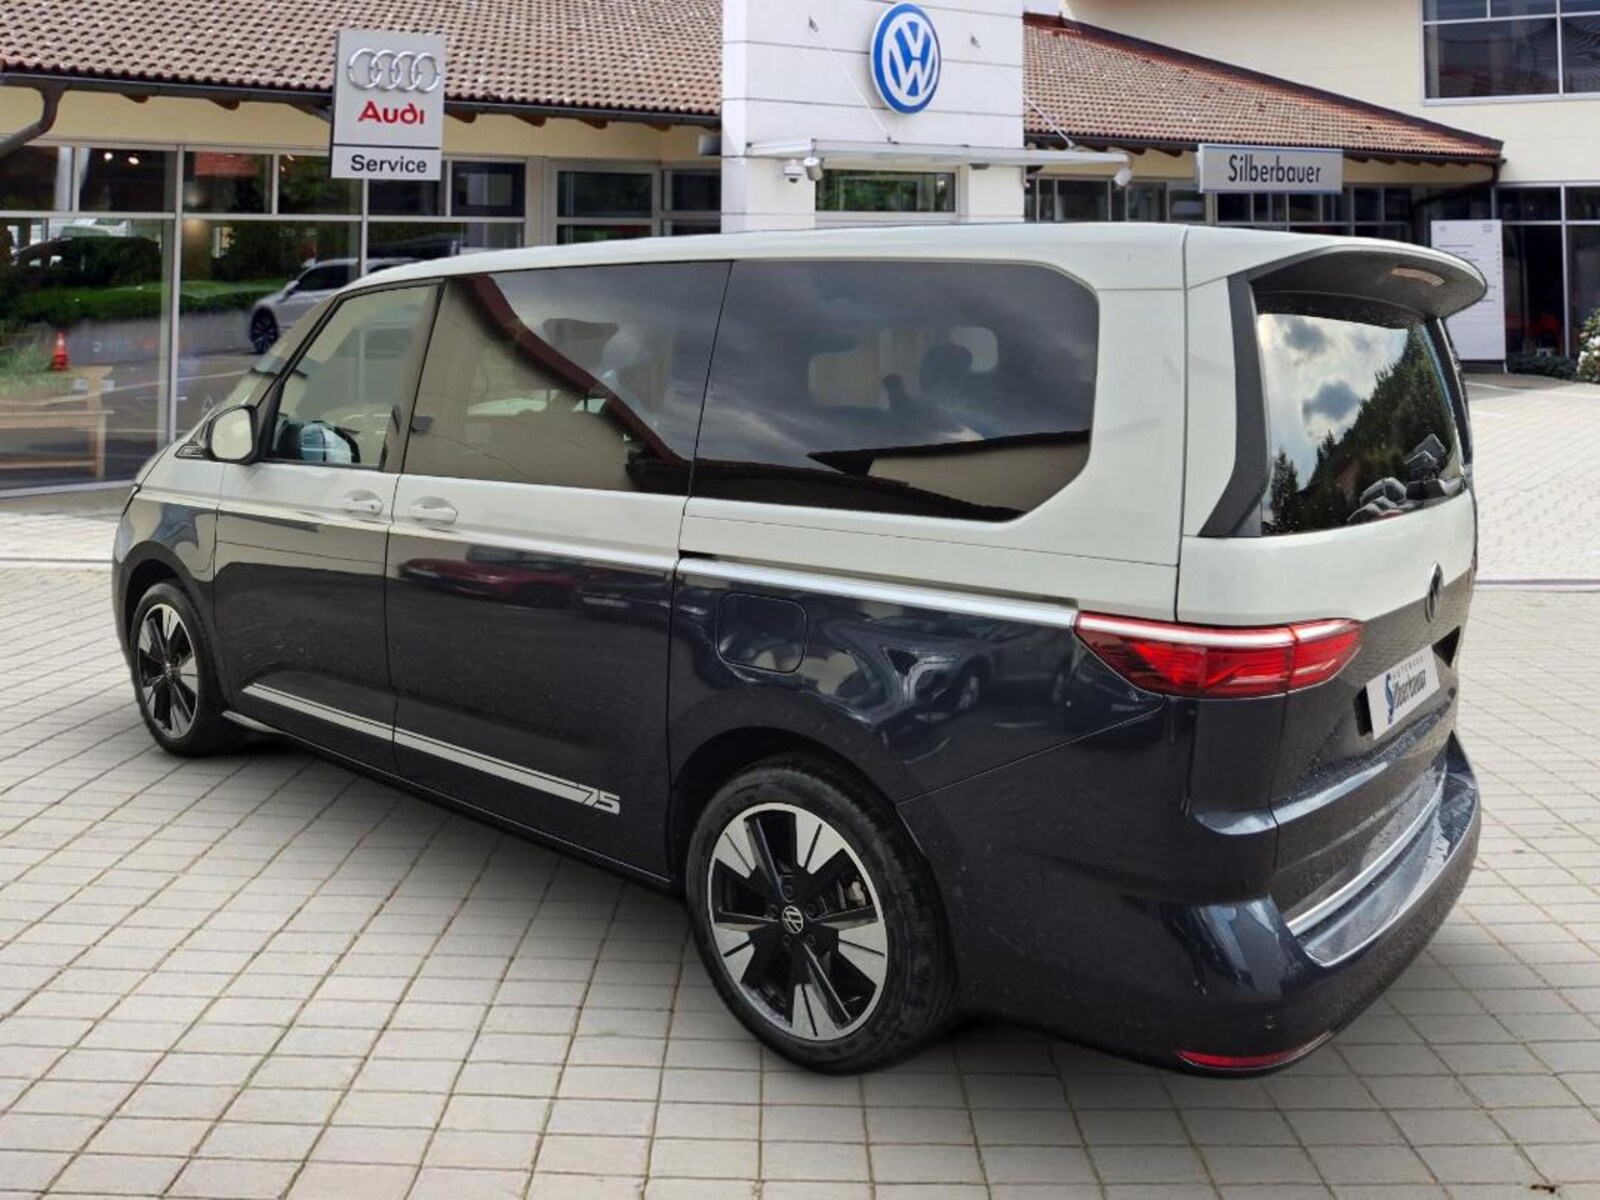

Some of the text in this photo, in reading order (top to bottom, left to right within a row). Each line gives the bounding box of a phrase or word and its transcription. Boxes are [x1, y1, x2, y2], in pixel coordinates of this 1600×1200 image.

[358, 100, 425, 125] Audi
[350, 154, 427, 173] Service
[1228, 154, 1321, 183] Silberbauer
